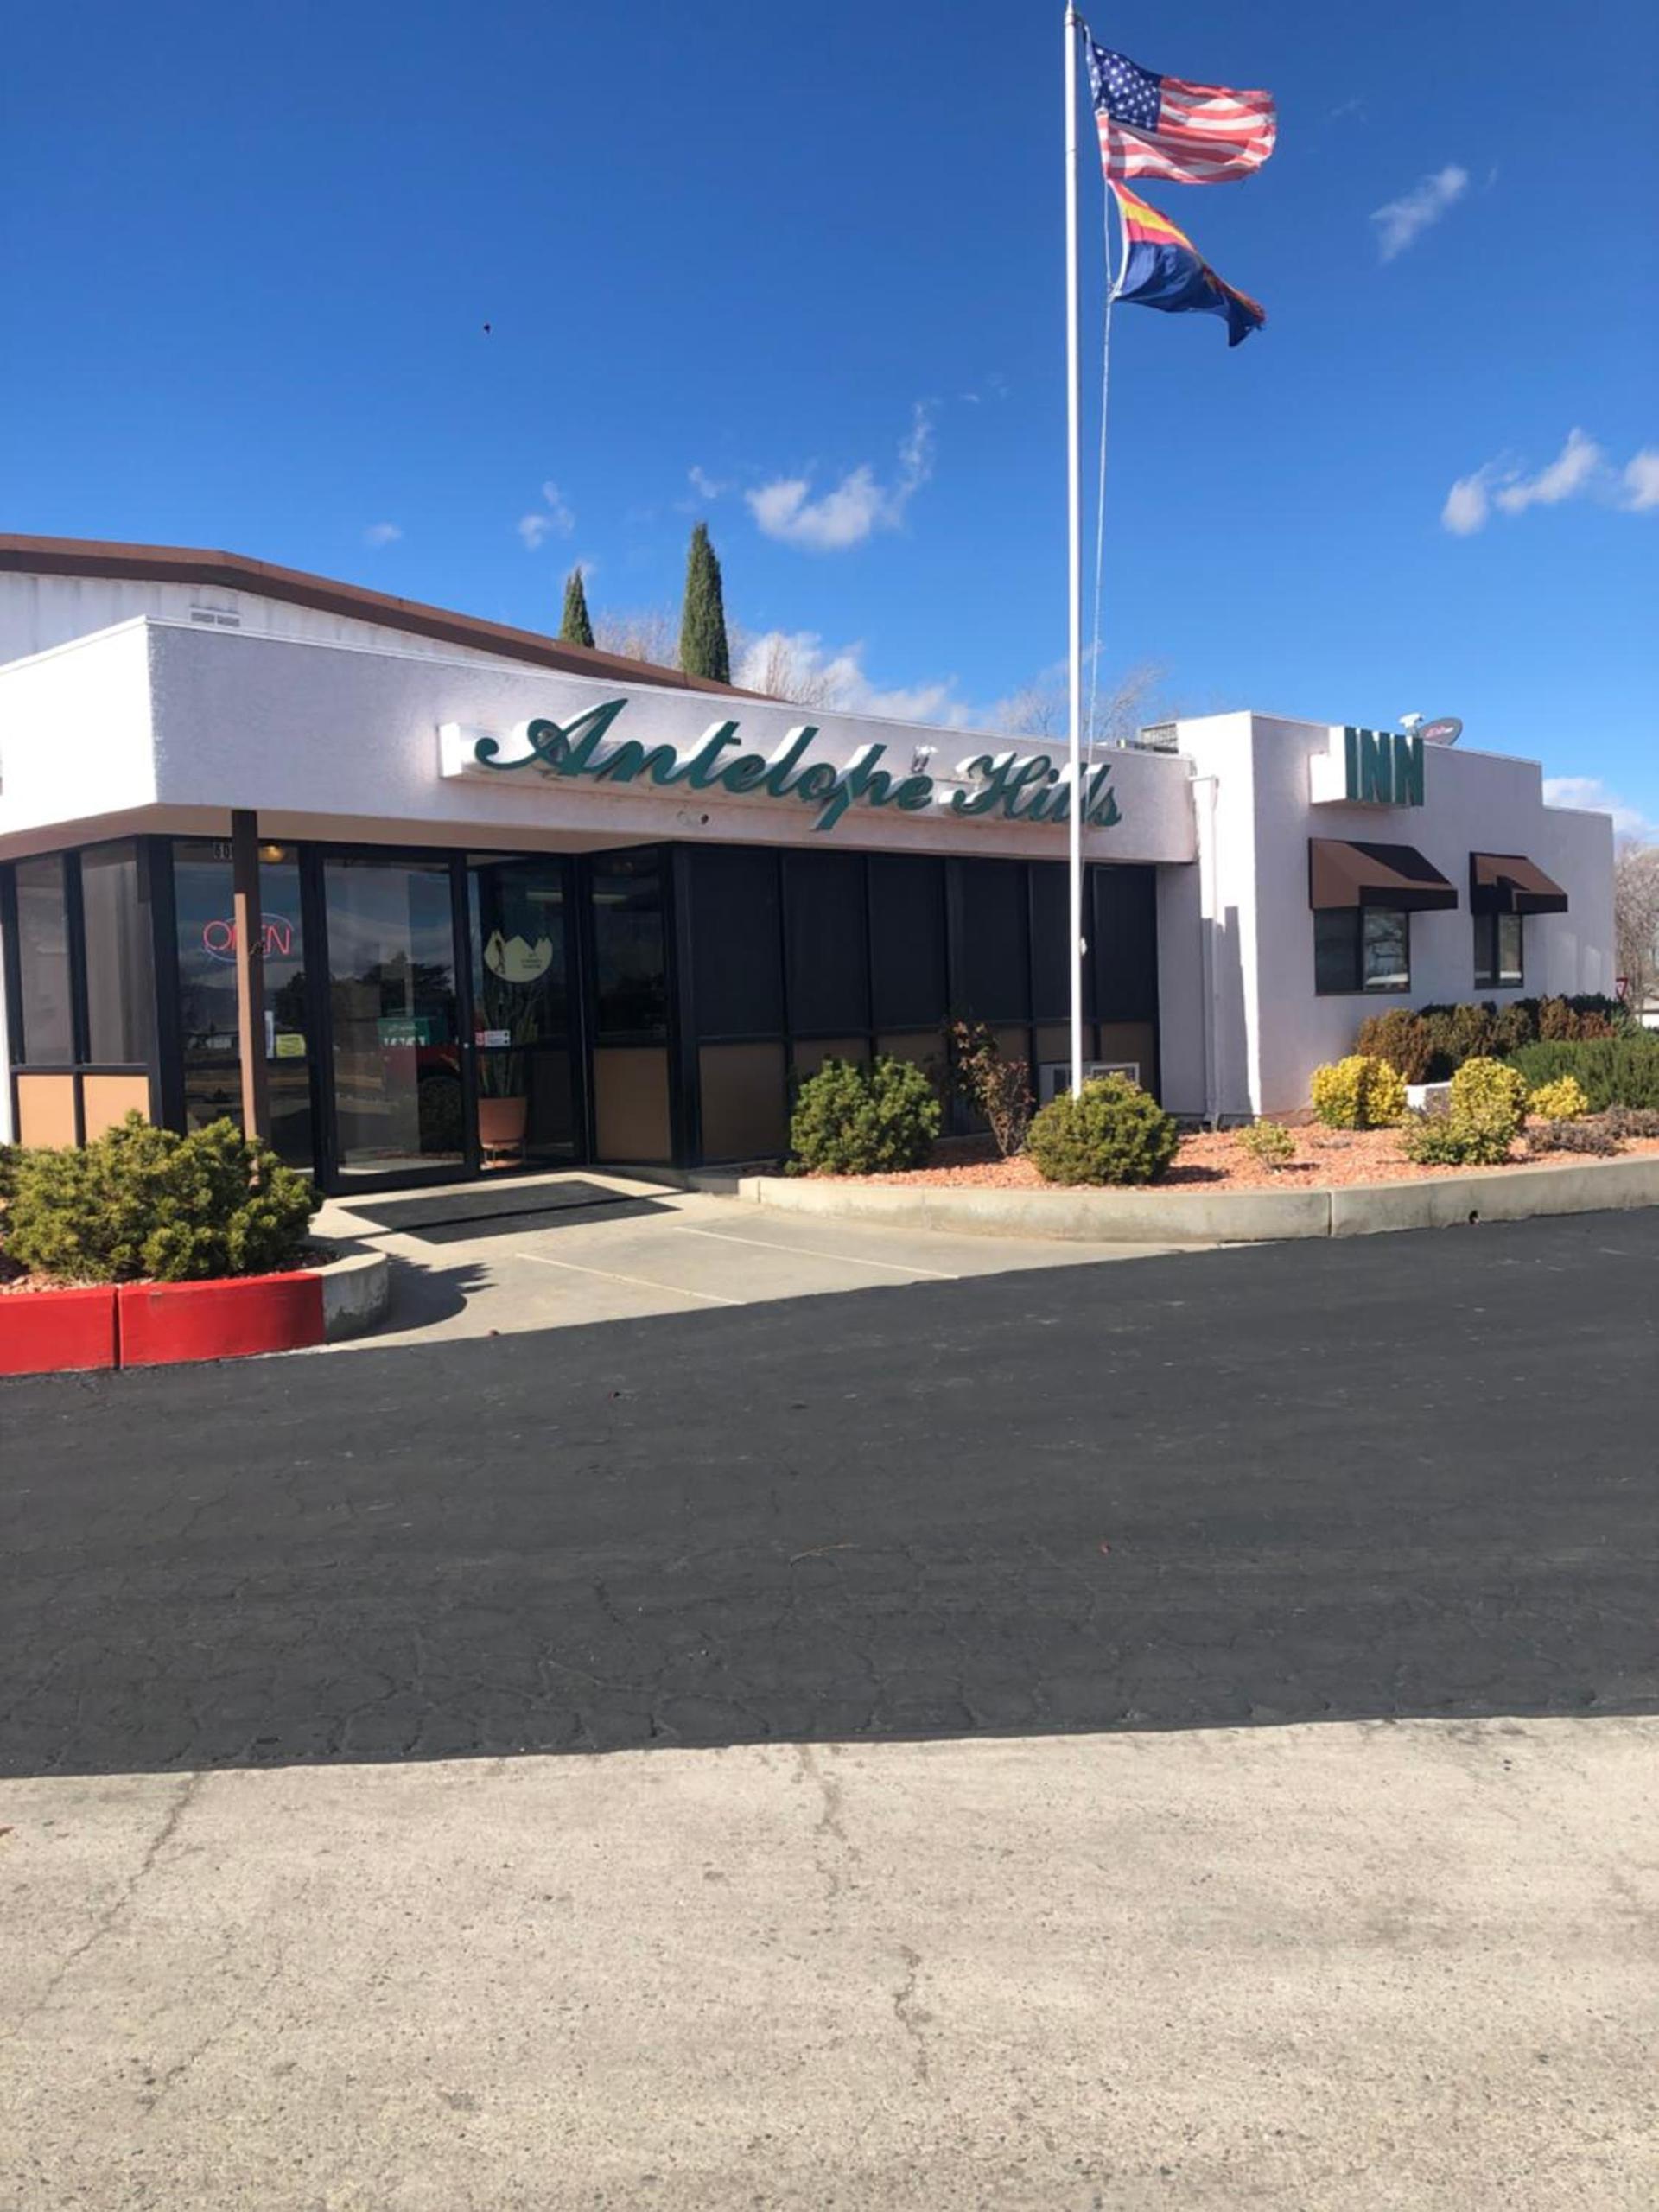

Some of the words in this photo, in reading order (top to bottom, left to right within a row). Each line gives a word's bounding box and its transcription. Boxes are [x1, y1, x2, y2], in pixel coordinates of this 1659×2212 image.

[474, 698, 933, 832] Antelope
[952, 752, 1122, 827] Hills
[1344, 726, 1424, 806] INN
[203, 919, 292, 955] ON
